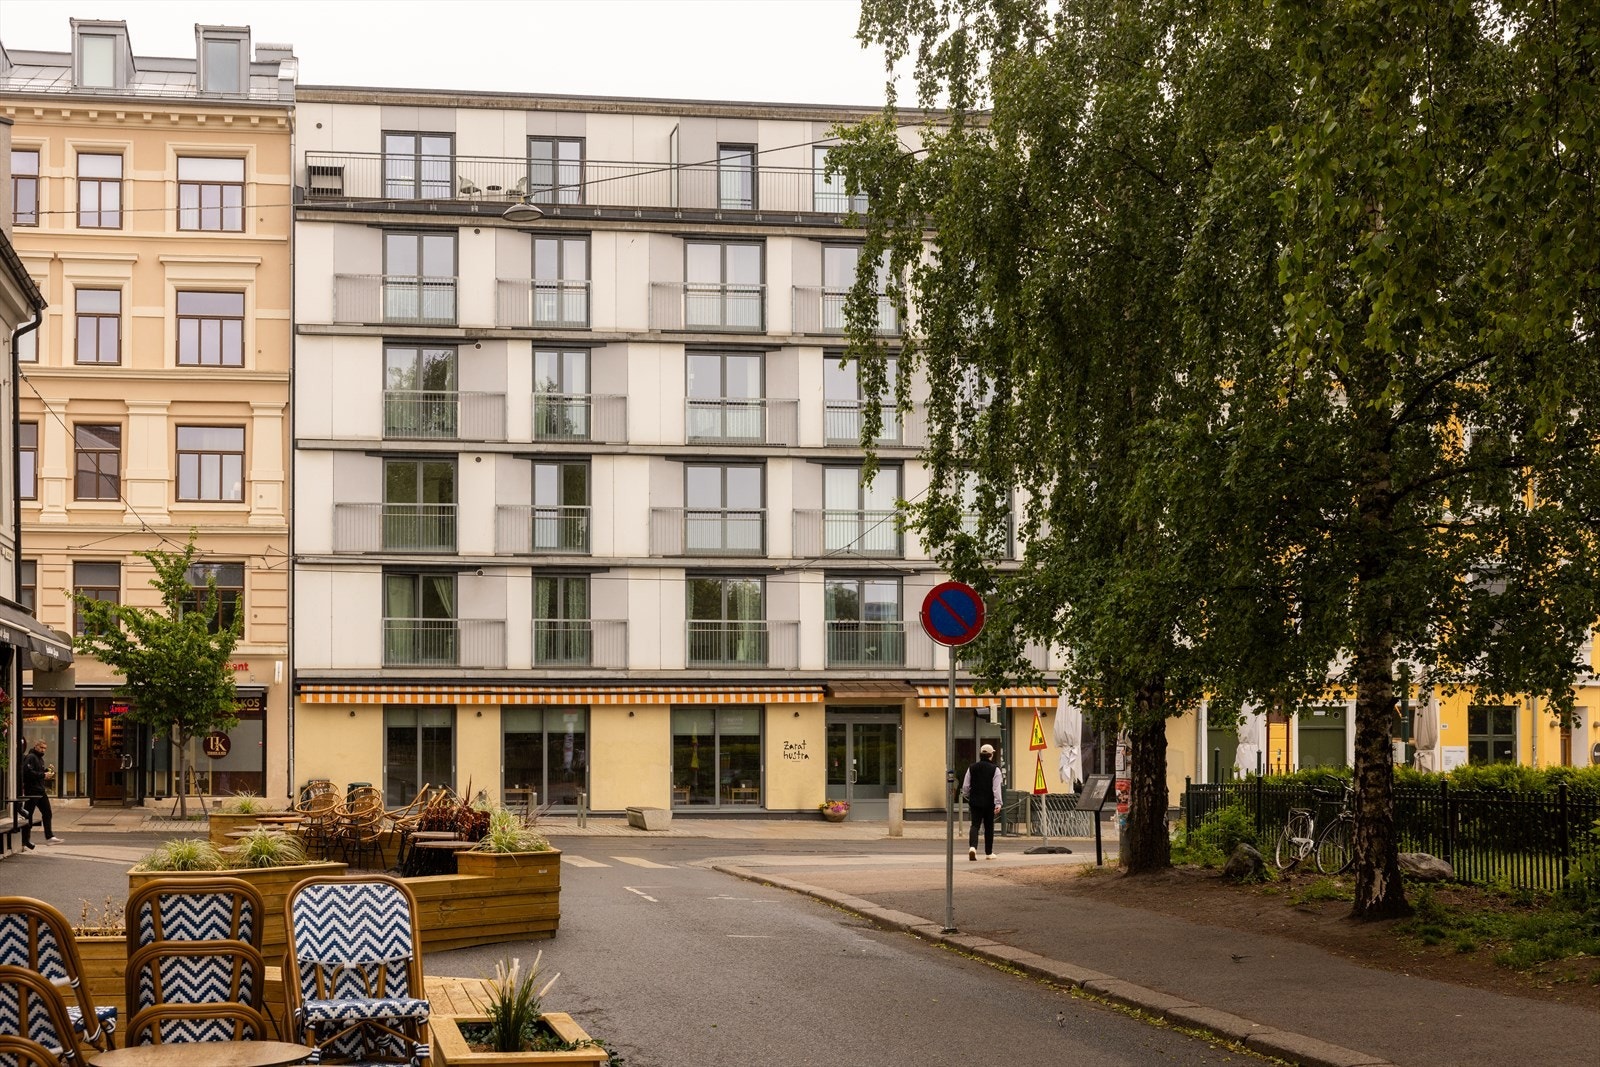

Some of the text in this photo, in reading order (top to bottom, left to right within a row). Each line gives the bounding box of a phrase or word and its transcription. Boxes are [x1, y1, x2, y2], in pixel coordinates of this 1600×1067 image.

[27, 698, 35, 707] &
[37, 698, 56, 707] KOS
[240, 698, 260, 708] KOS
[784, 750, 809, 760] hustra
